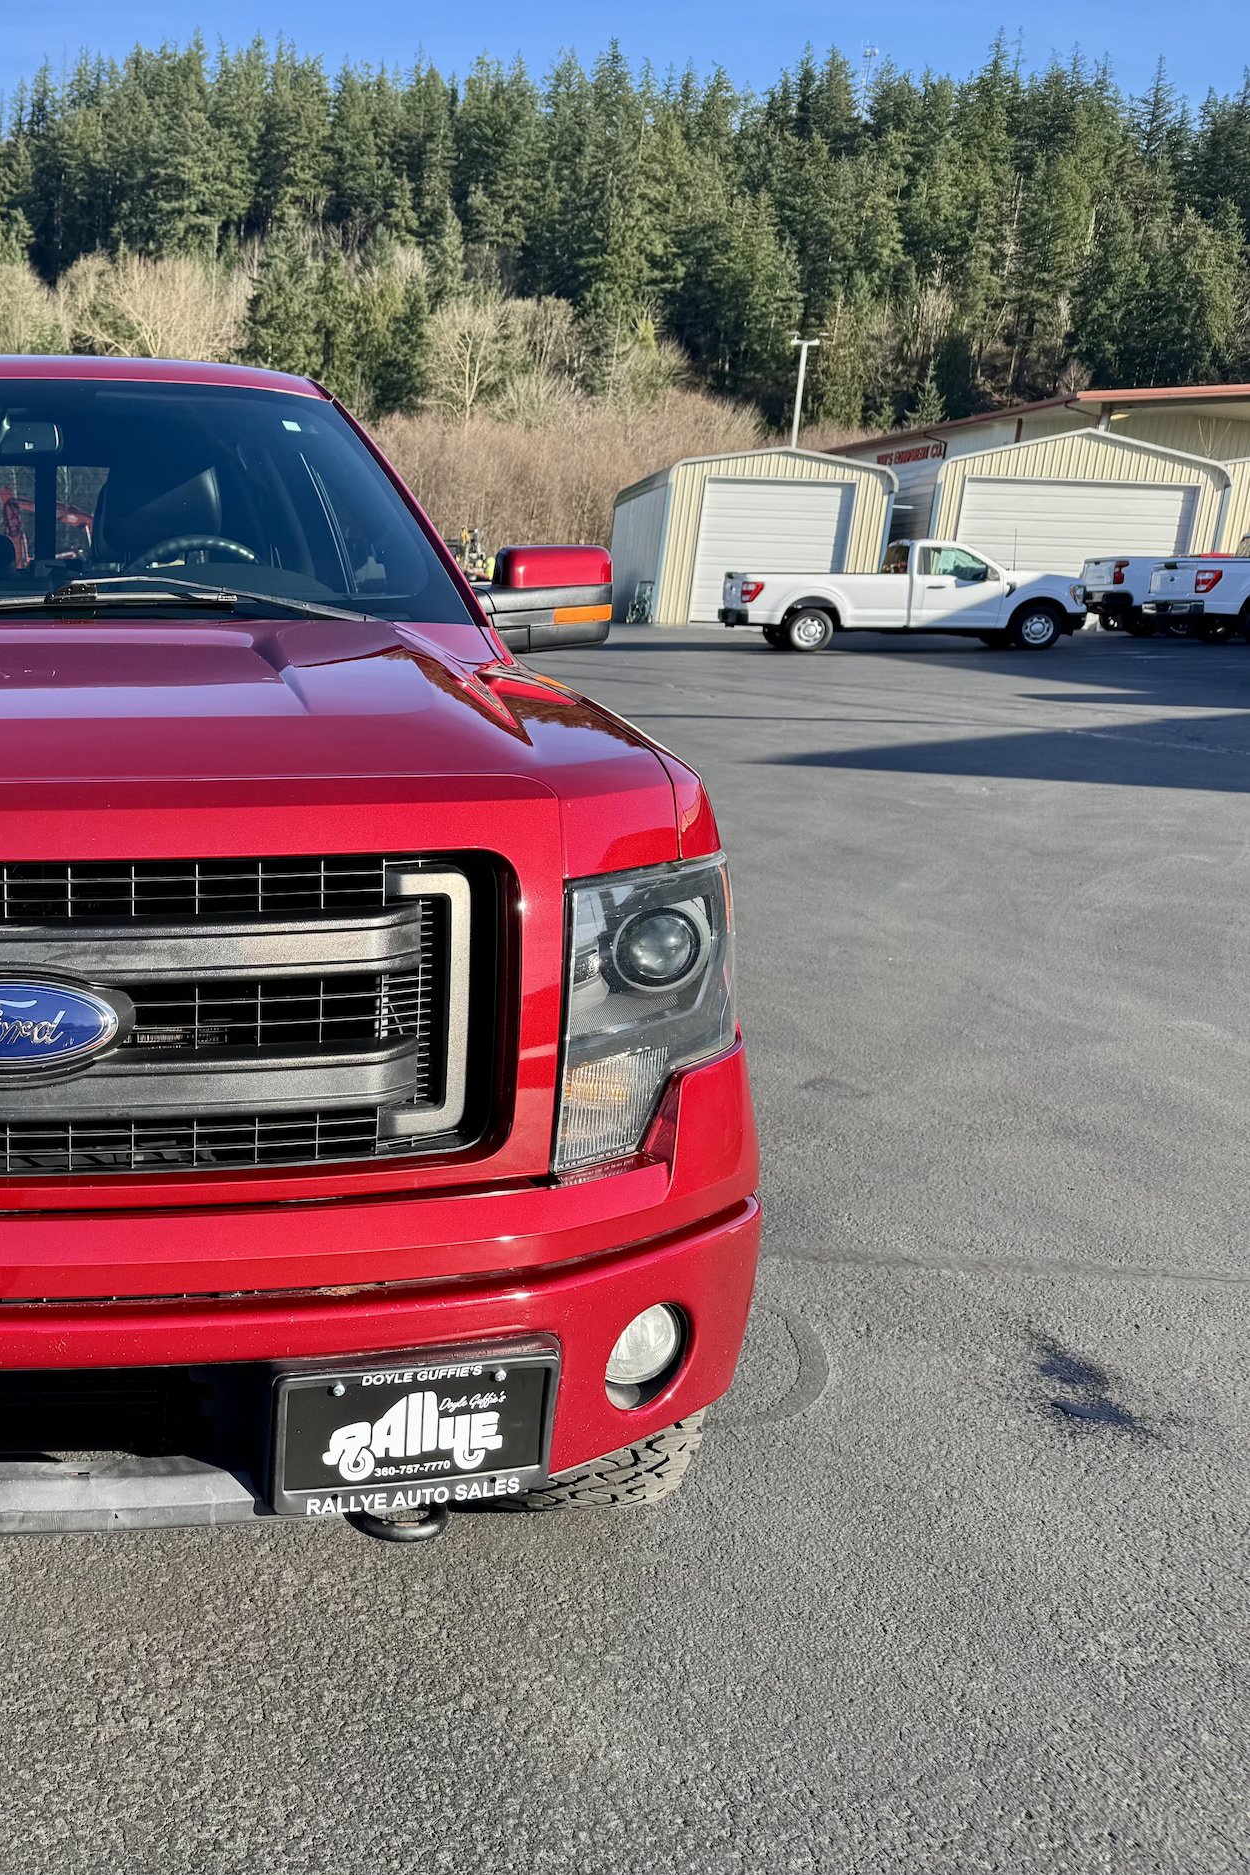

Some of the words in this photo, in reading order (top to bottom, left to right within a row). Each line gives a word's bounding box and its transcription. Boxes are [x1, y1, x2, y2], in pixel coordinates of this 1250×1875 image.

[362, 1372, 413, 1386] DOYLE
[417, 1365, 483, 1382] GUFFIE'S
[439, 1396, 468, 1412] Doyle
[469, 1391, 506, 1409] Guffie's
[375, 1460, 451, 1477] 360-757-7770
[307, 1493, 388, 1515] RALLYE
[392, 1486, 449, 1508] AUTO
[454, 1477, 520, 1501] SALES
